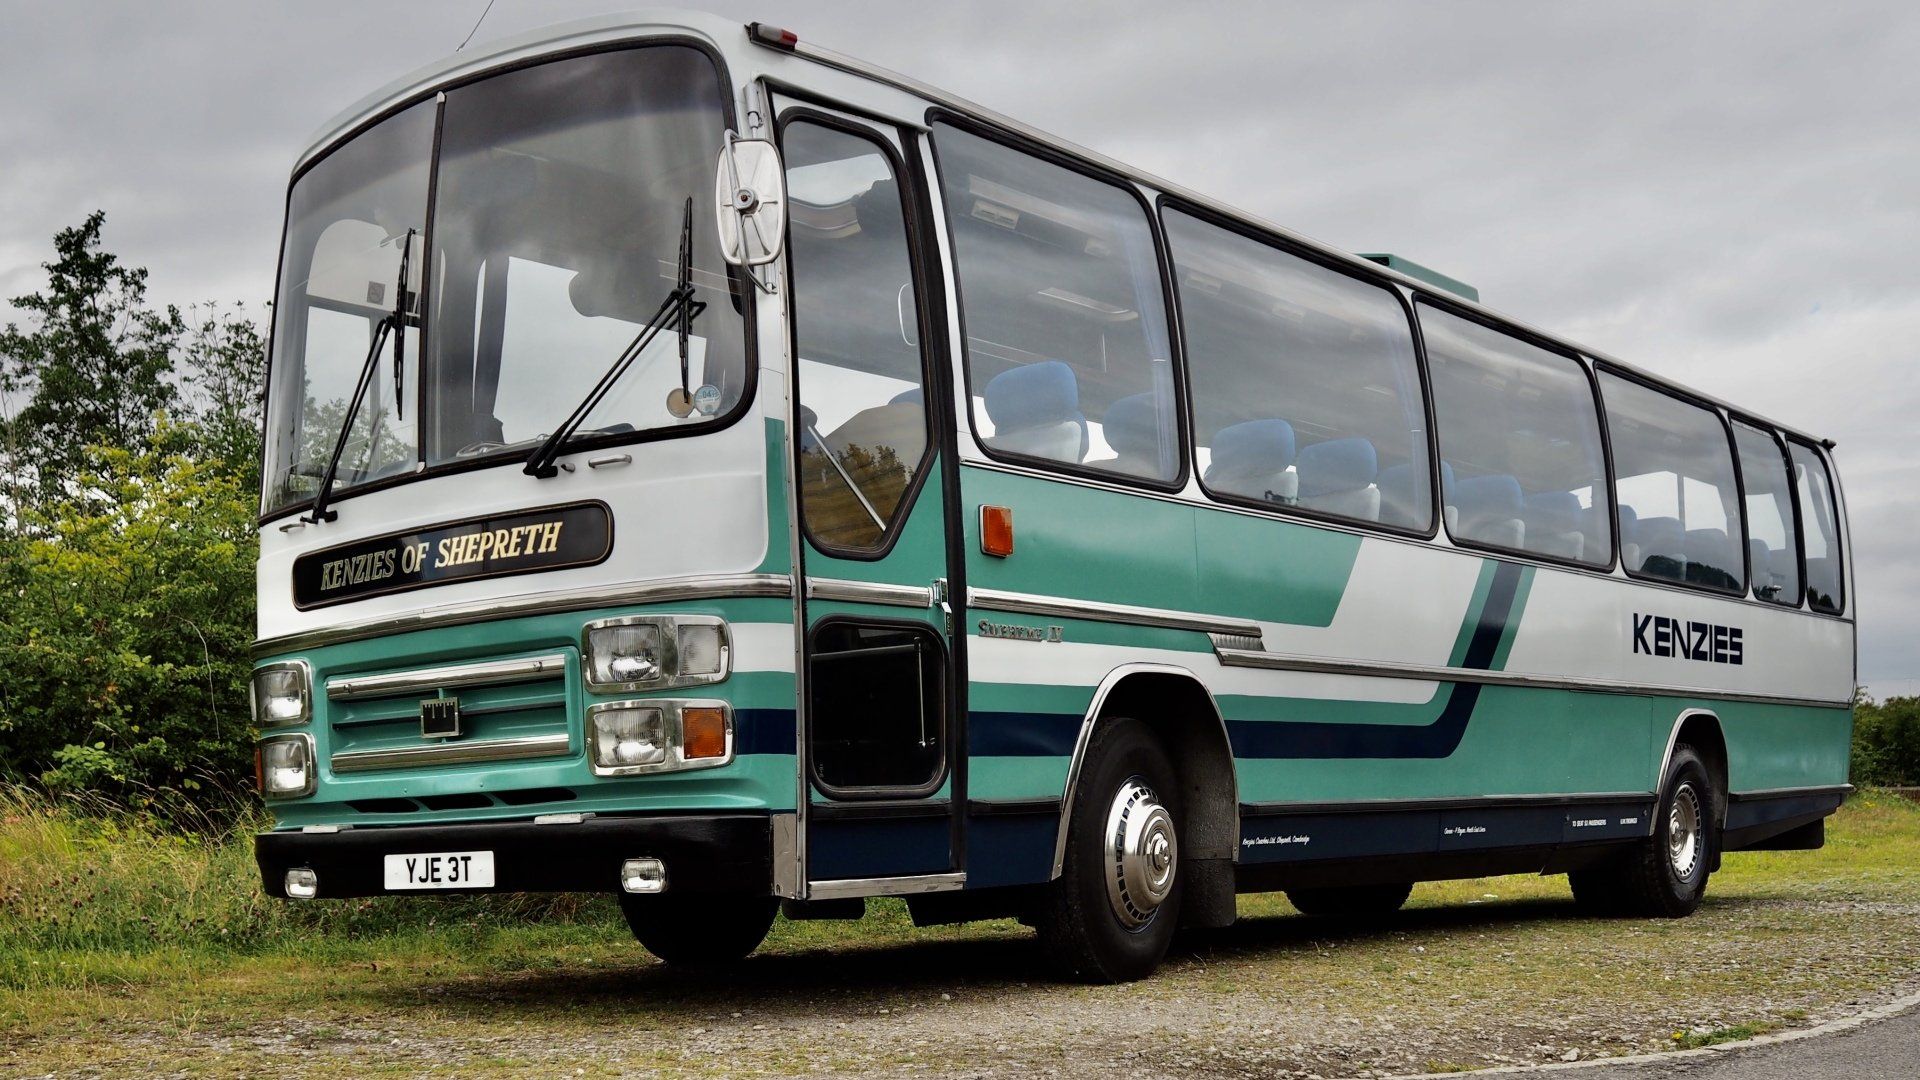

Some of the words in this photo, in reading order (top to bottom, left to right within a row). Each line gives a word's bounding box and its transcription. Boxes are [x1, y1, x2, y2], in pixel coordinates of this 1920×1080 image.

[320, 548, 397, 591] KENZIES
[401, 542, 430, 574] OF
[434, 521, 564, 569] SHEPRETH
[1633, 612, 1743, 665] KENZIES
[405, 857, 442, 884] YJE
[447, 855, 472, 882] 3T
